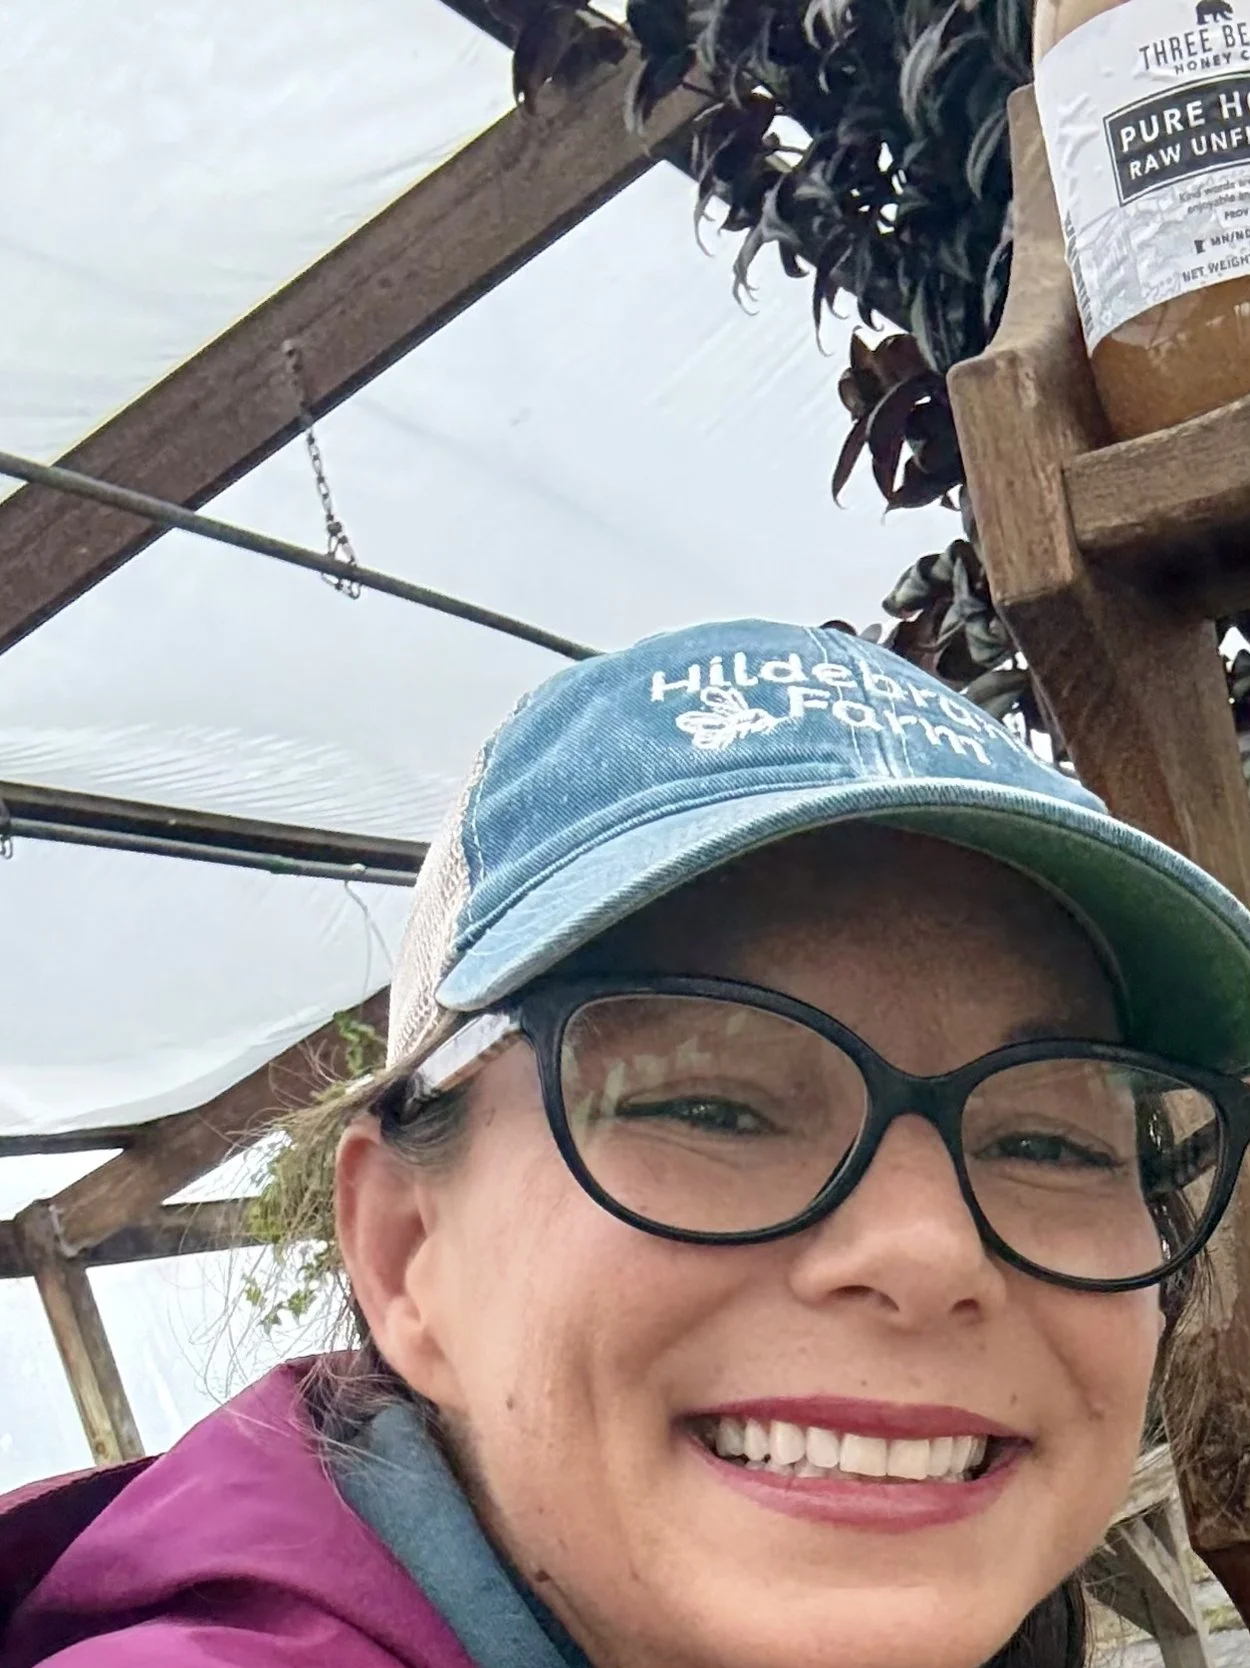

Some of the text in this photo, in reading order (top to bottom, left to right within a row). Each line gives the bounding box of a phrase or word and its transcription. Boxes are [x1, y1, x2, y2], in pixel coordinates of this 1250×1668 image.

[1139, 29, 1212, 70] THREE
[1175, 52, 1232, 75] HONEY
[1120, 101, 1205, 151] PURE
[1129, 143, 1180, 180] RAW
[1182, 266, 1204, 283] NET
[790, 685, 991, 765] Farm
